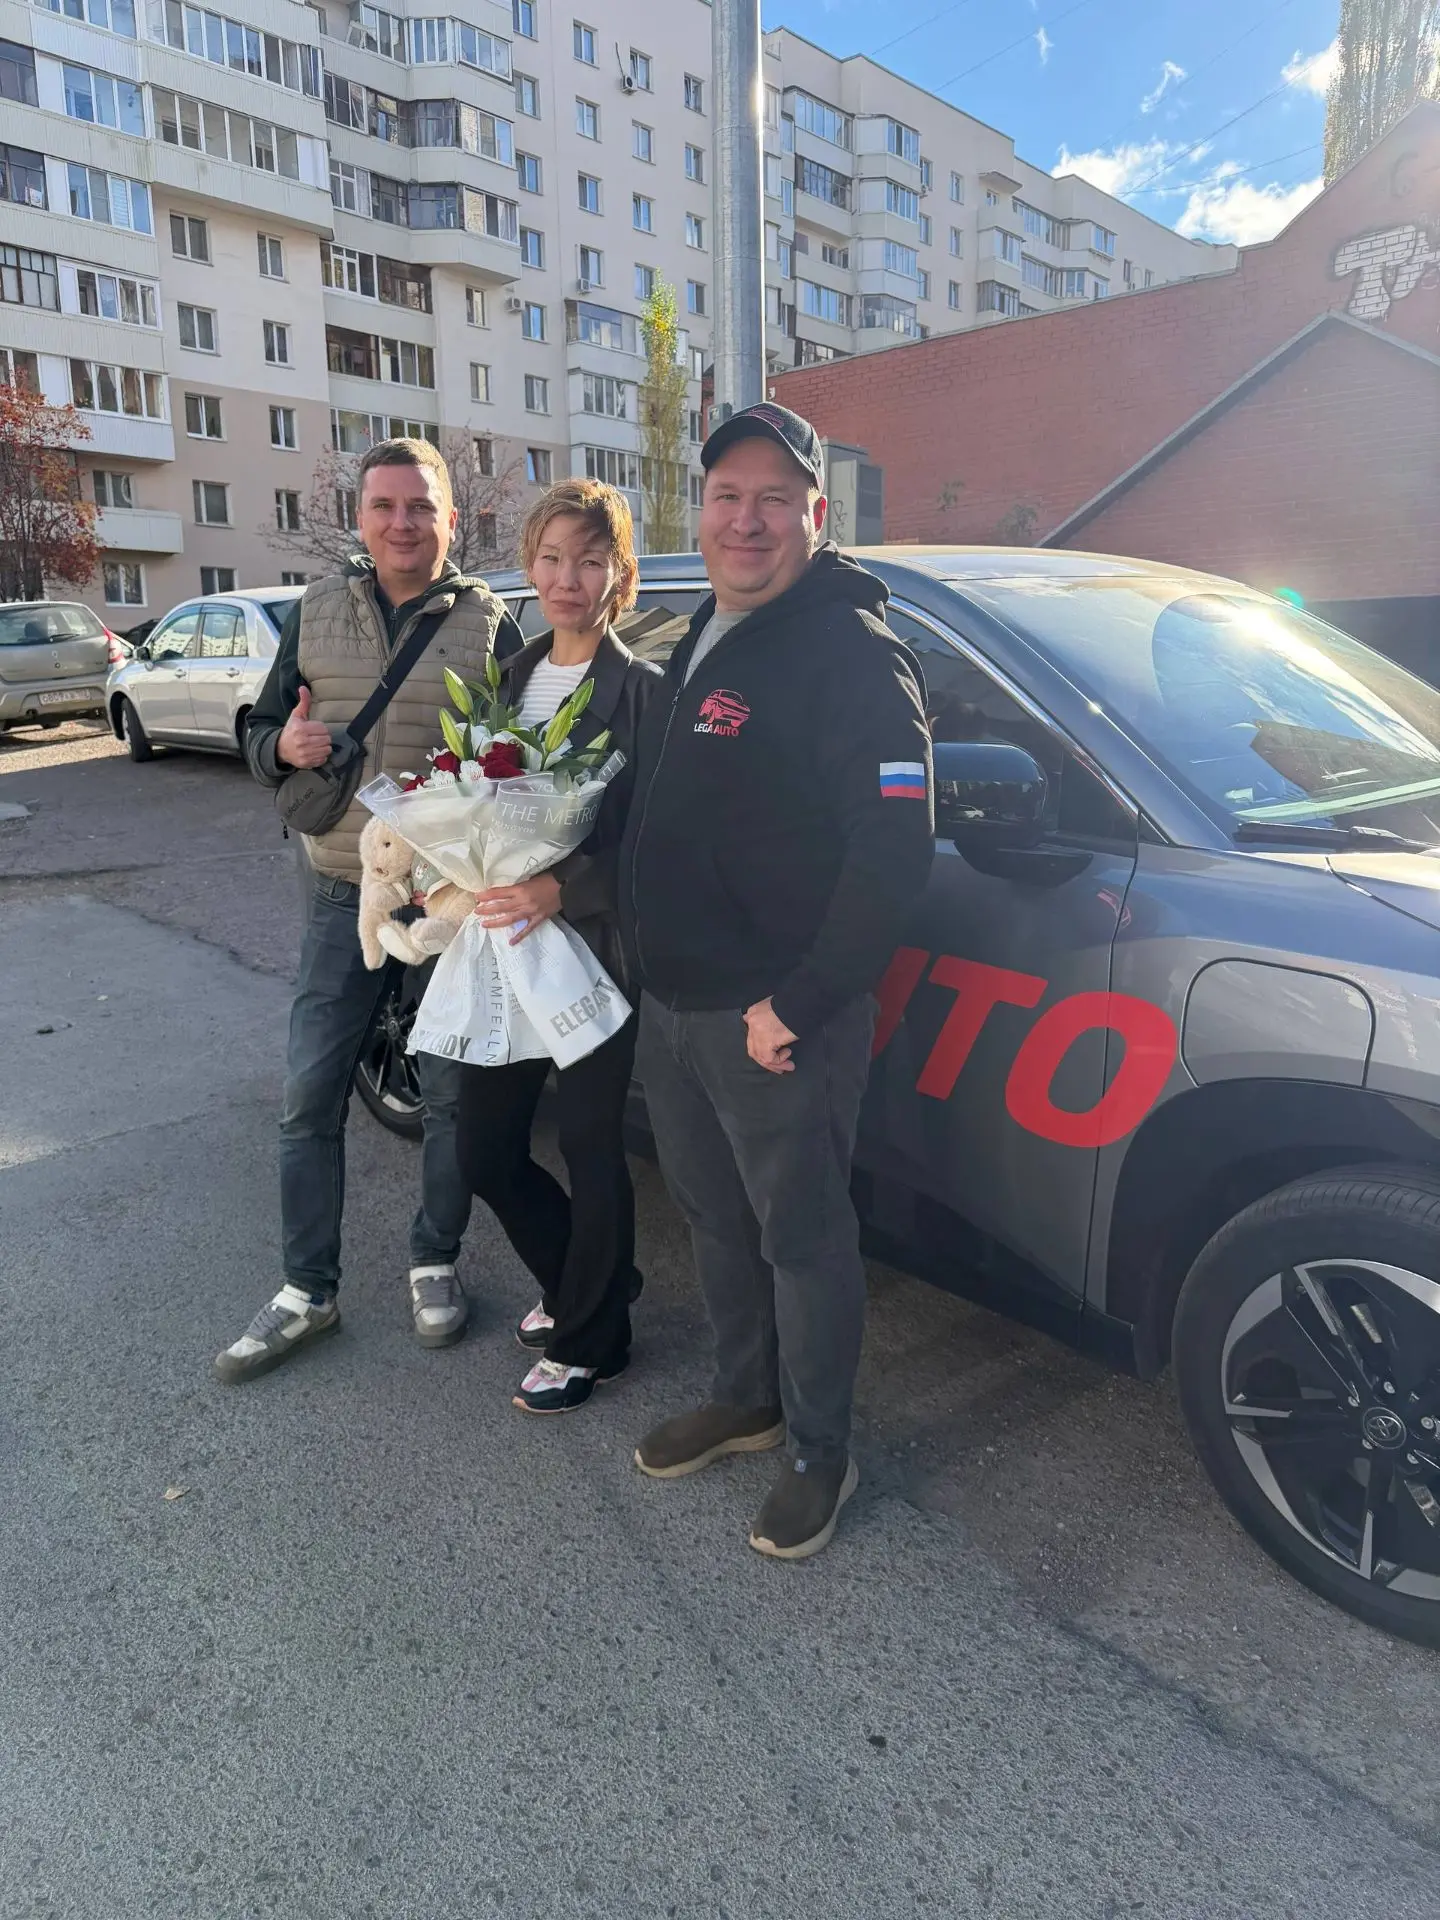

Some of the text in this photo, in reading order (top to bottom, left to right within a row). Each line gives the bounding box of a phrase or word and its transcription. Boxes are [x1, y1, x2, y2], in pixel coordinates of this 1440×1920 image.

[694, 723, 739, 737] LEGA AUTO
[501, 802, 600, 826] THE METRO
